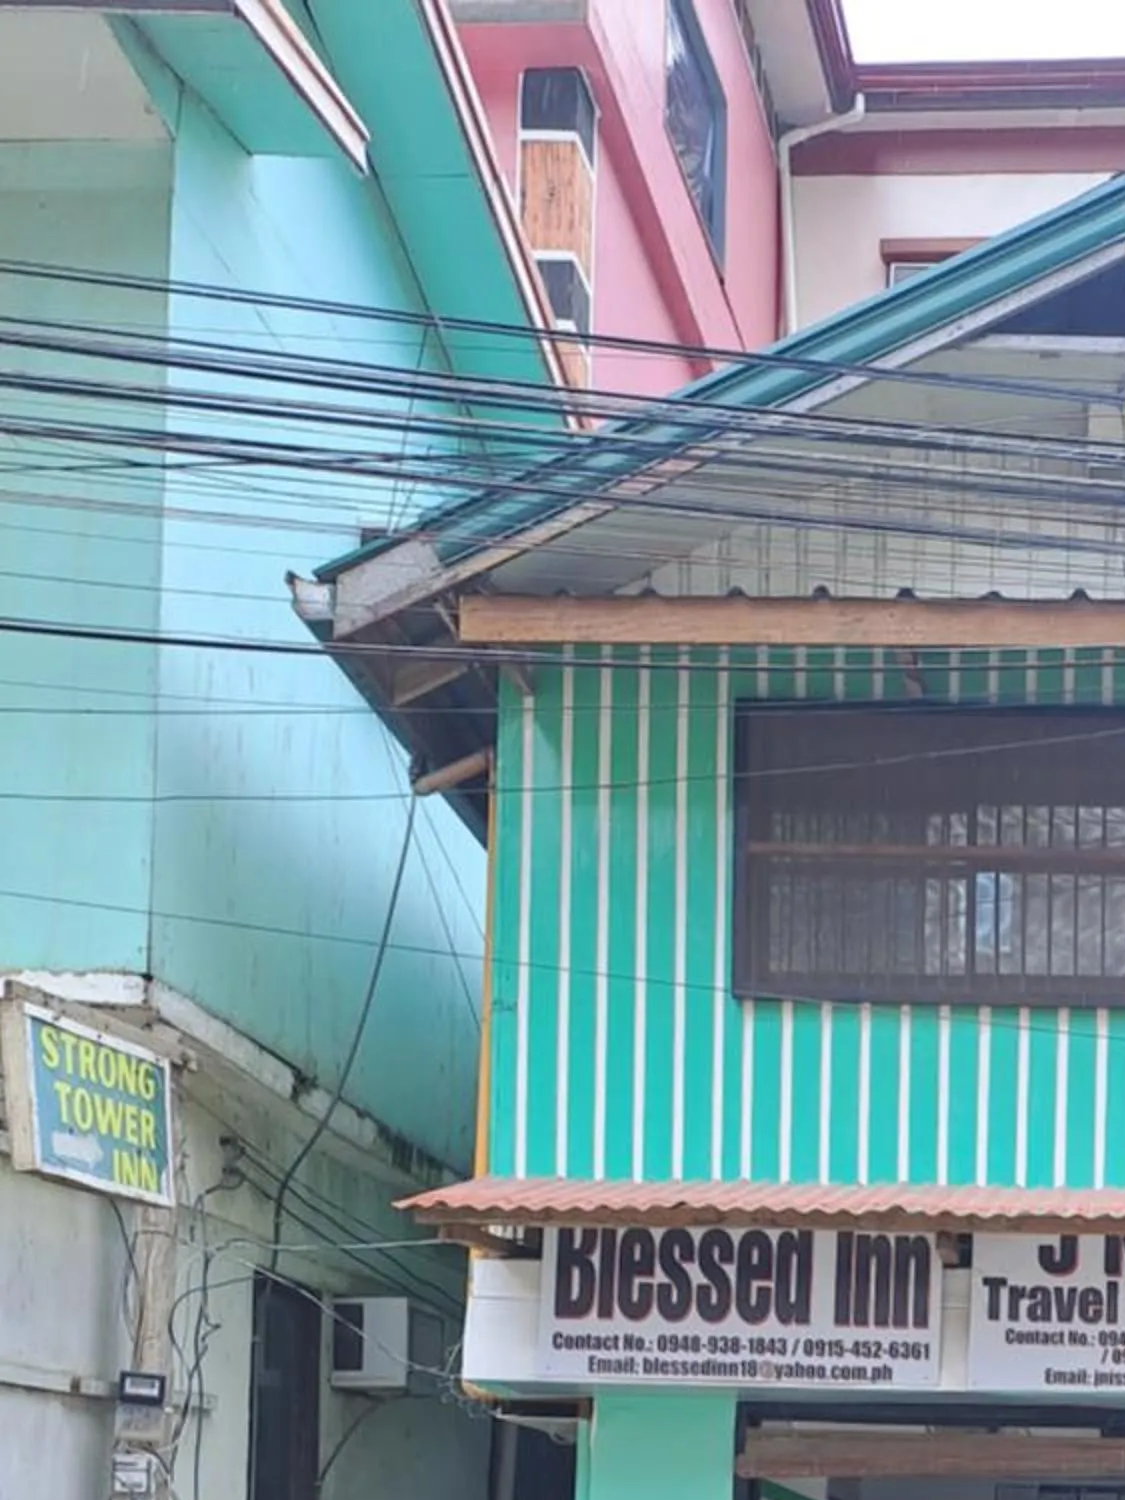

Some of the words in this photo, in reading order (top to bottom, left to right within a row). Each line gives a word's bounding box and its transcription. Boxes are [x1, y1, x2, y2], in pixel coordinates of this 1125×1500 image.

[41, 1025, 155, 1100] STRONG
[54, 1081, 156, 1149] TOWER
[113, 1149, 157, 1191] INN
[554, 1227, 813, 1325] Blessed
[833, 1231, 931, 1329] Inn
[982, 1276, 1118, 1325] Travel
[552, 1332, 619, 1350] Contact
[623, 1334, 653, 1352] No.:
[657, 1334, 787, 1356] 0948-938-1843
[791, 1337, 800, 1356] /
[803, 1339, 930, 1360] 0915-452-6361
[1005, 1328, 1064, 1345] Contact
[1068, 1330, 1096, 1347] No.:
[588, 1355, 640, 1374] Email:
[1044, 1367, 1093, 1385] Email:
